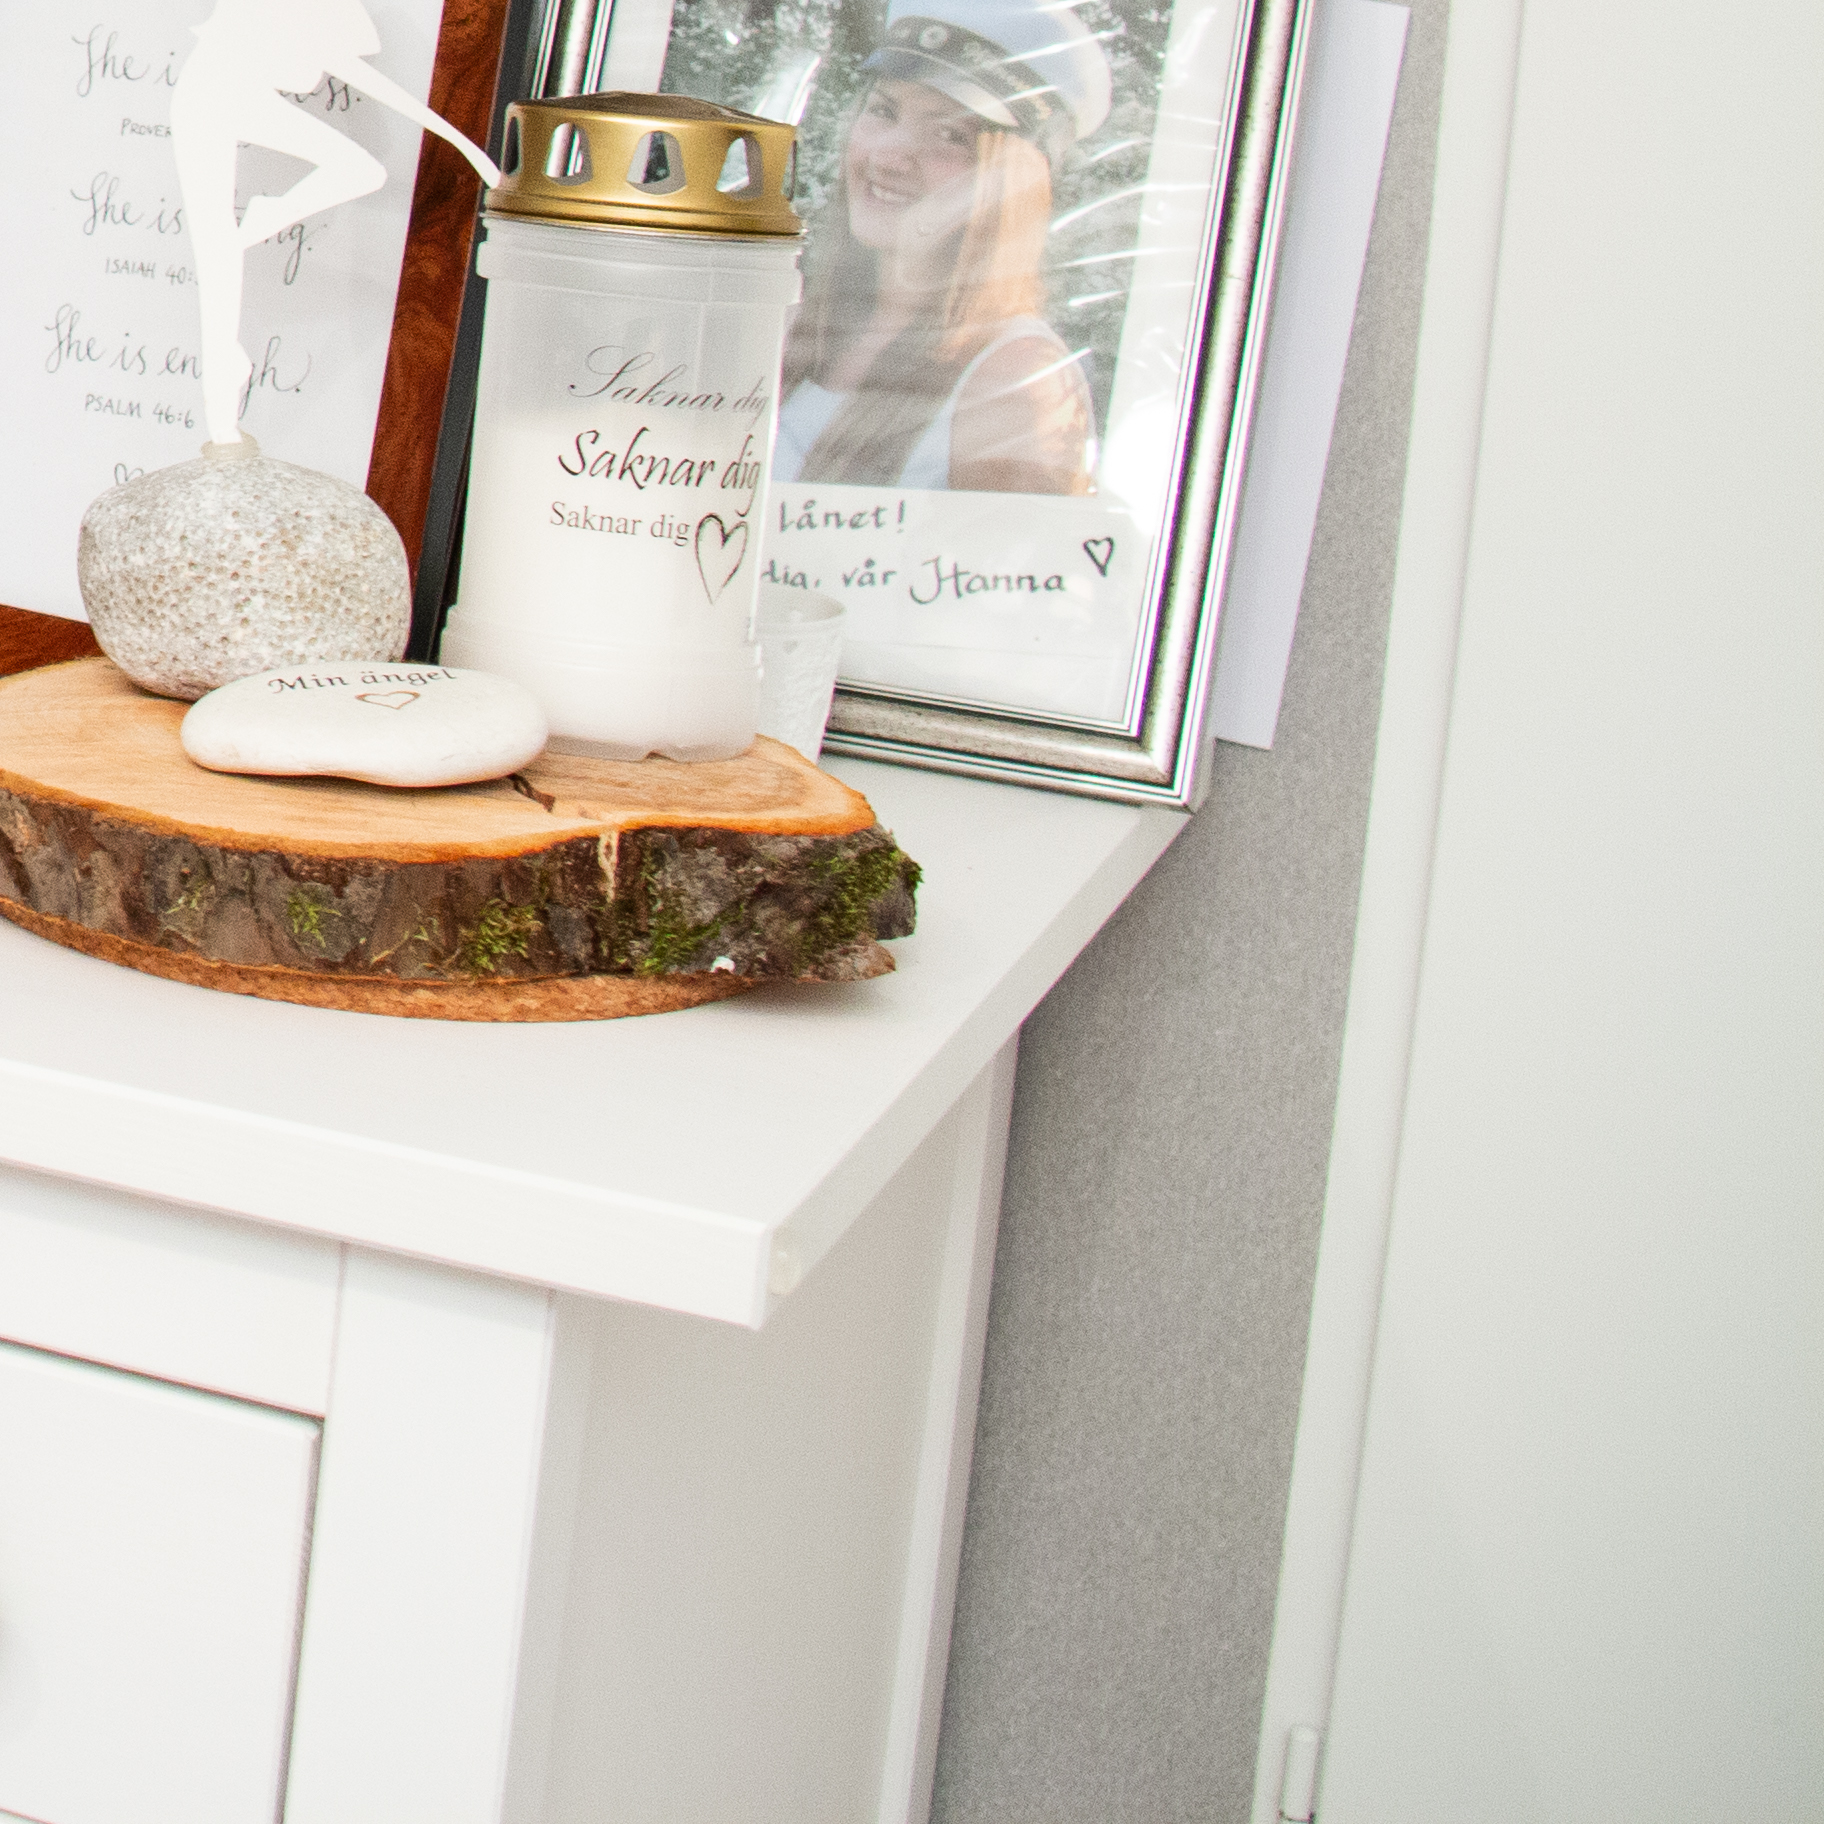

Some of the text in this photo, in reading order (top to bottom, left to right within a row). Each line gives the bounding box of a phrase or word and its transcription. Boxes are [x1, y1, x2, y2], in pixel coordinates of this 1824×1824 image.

[147, 197, 183, 234] is
[104, 258, 199, 287] ISAIAH 40:
[109, 332, 147, 376] is
[85, 392, 142, 418] PSALM
[567, 345, 770, 432] Saknar dig
[558, 427, 761, 517] Saknar dig
[550, 501, 691, 547] Saknar dig
[841, 557, 898, 589] vår
[908, 555, 1066, 605] Hanna
[267, 667, 457, 695] Min ängel
